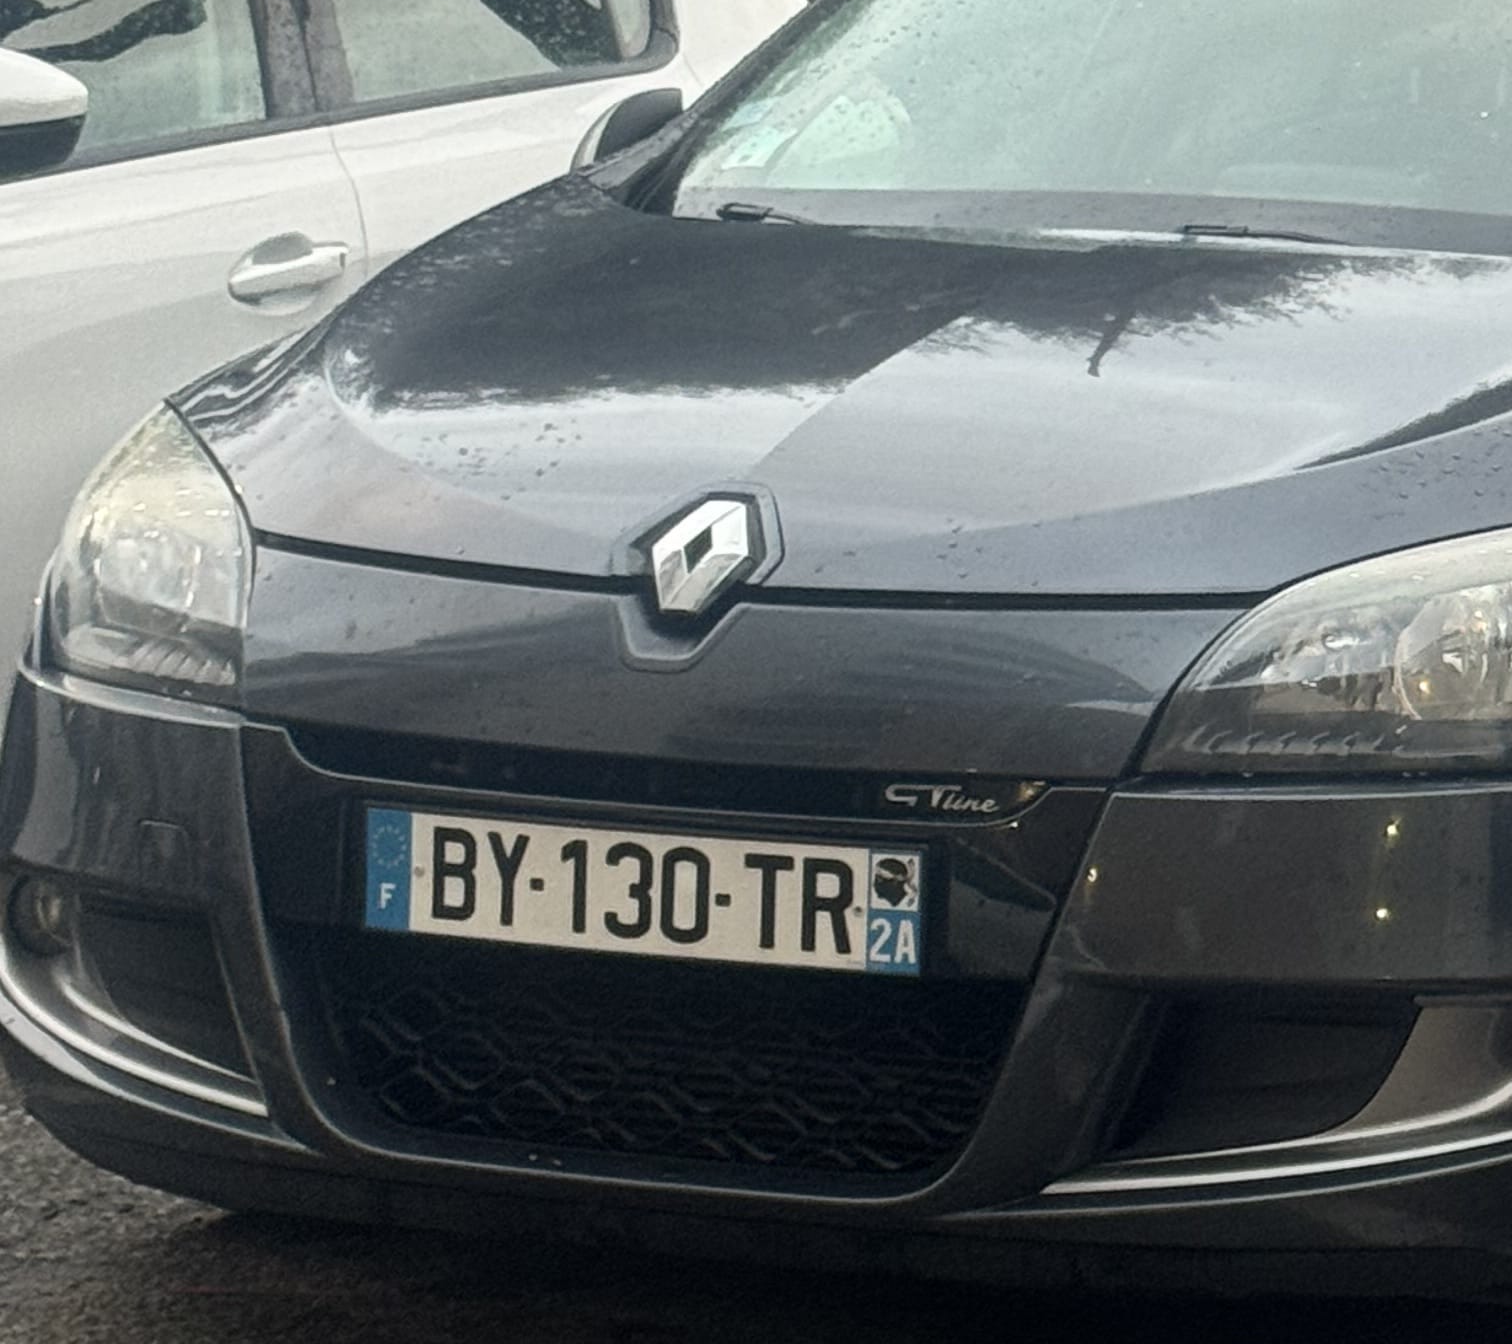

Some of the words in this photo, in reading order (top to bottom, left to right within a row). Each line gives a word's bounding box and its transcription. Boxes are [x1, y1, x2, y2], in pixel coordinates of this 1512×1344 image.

[378, 882, 397, 910] F
[432, 825, 854, 955] BY-130-TR
[869, 917, 917, 964] 2A
